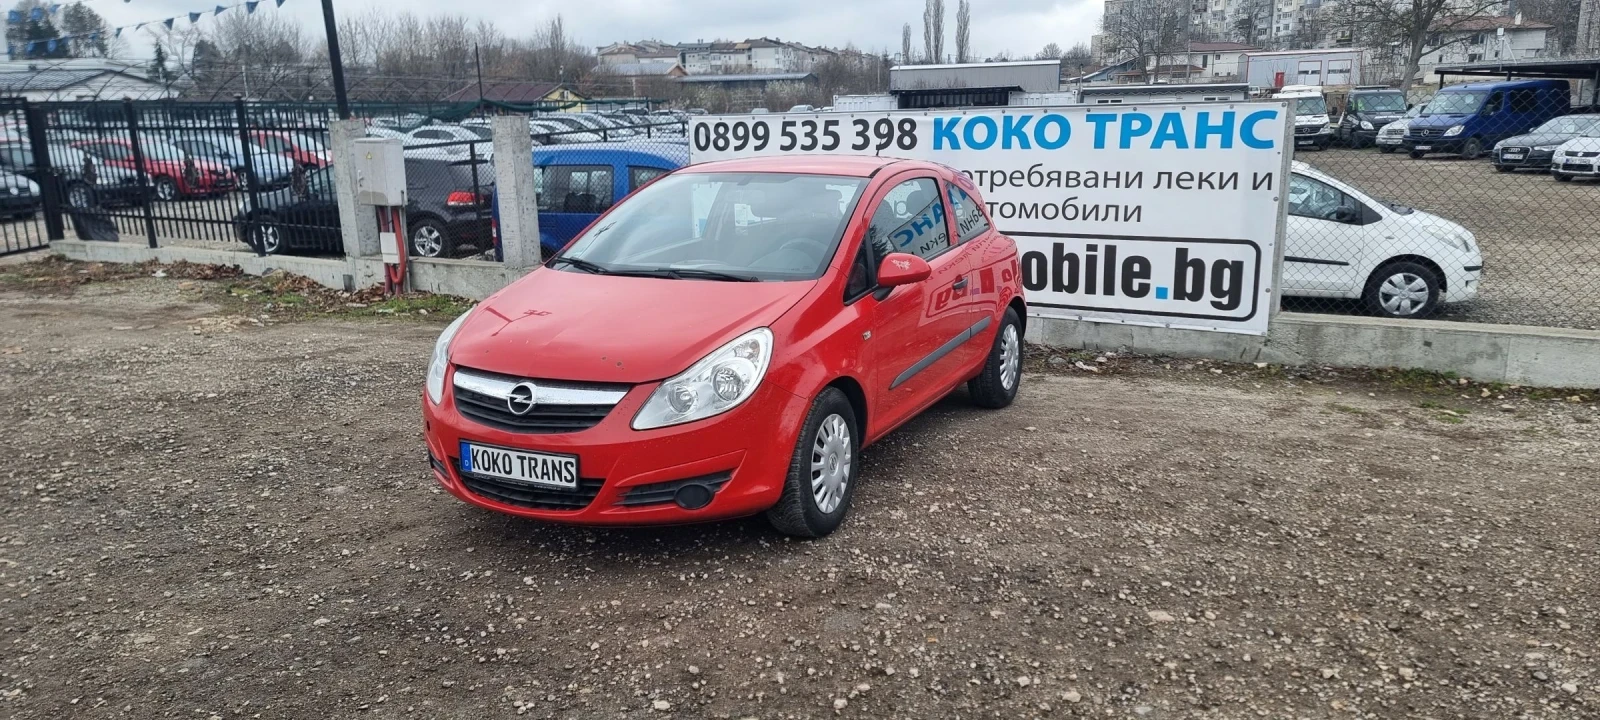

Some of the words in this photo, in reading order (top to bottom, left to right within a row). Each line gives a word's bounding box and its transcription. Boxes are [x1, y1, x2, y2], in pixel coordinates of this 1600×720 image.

[693, 120, 770, 151] 0899
[779, 119, 841, 151] 535
[851, 117, 918, 151] 398
[932, 113, 1072, 150] КОКО
[1085, 110, 1279, 150] ТРАНС
[1152, 170, 1240, 191] леки
[1252, 170, 1274, 191] и
[984, 196, 1143, 223] томобили
[1021, 242, 1245, 311] obile.bg
[471, 447, 513, 475] KOKO
[516, 454, 575, 483] TRANS
